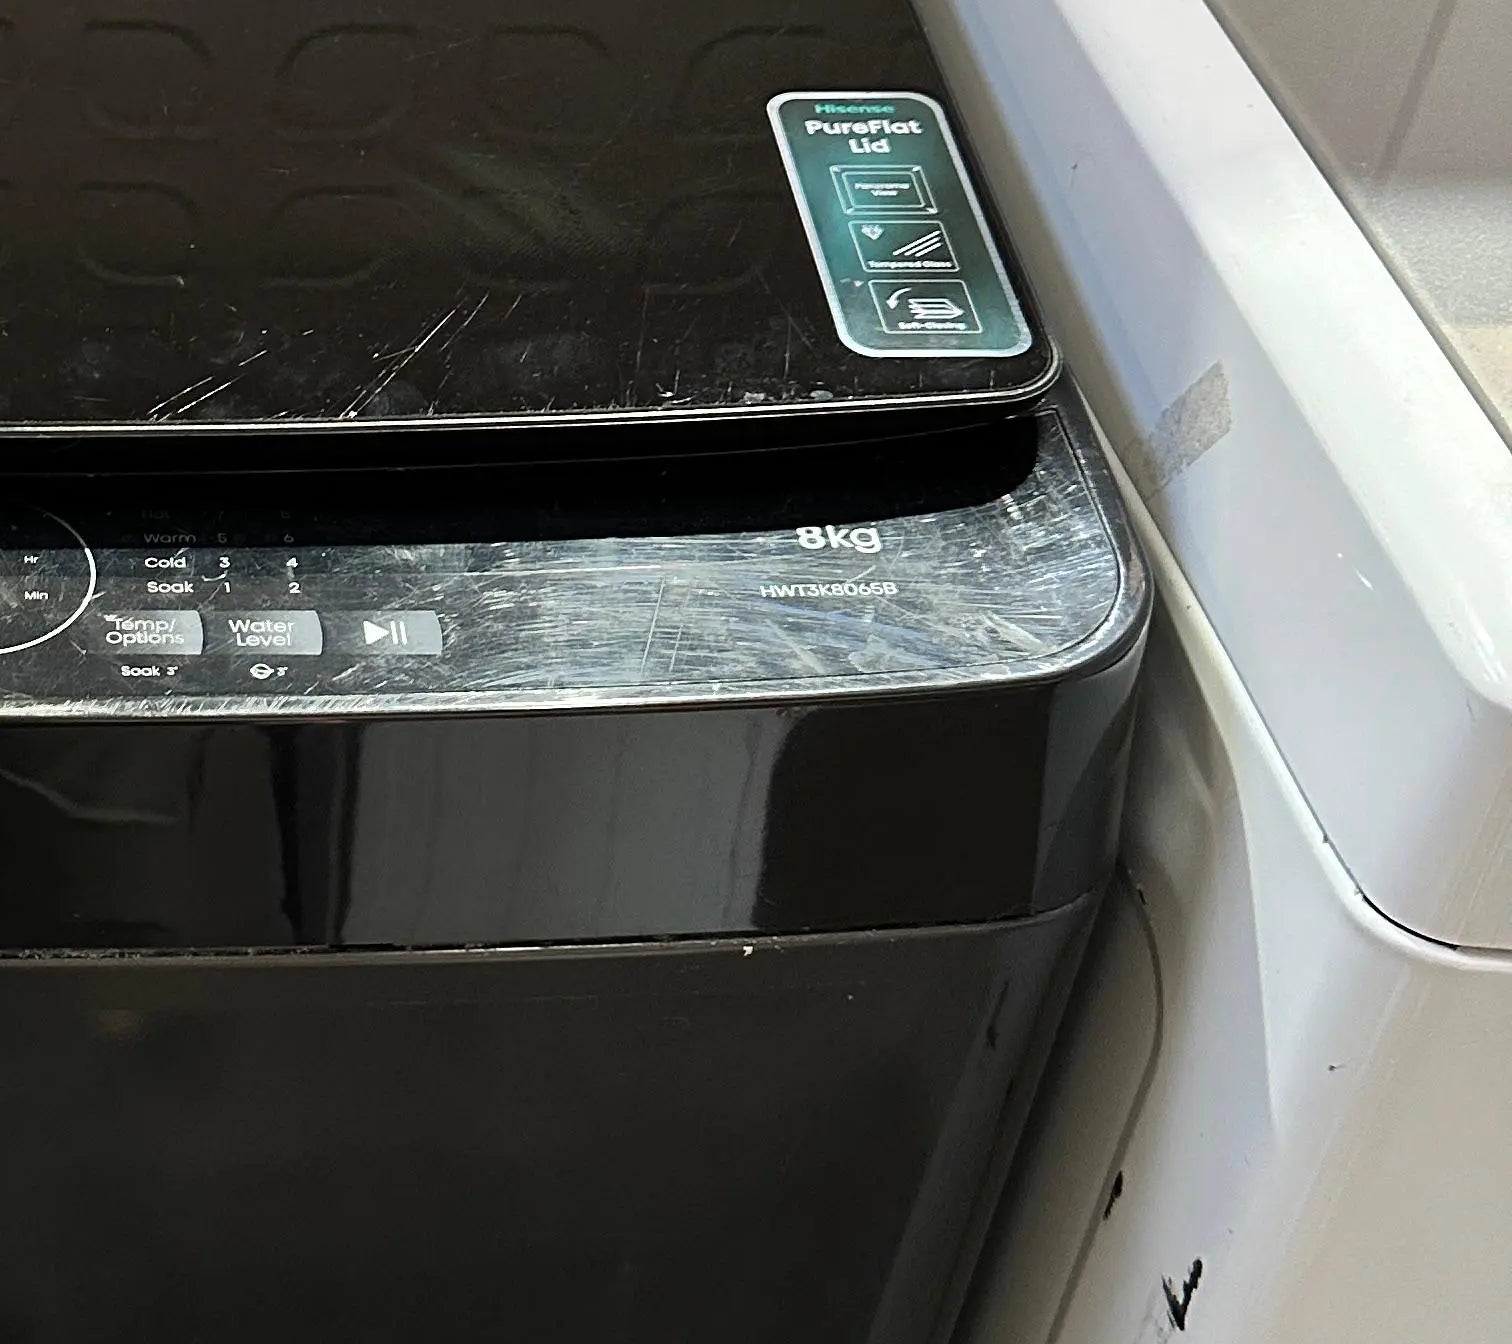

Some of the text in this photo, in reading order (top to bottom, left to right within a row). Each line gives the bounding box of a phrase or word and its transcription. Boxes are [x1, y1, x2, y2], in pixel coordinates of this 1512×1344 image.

[814, 103, 895, 115] Hisense
[804, 118, 924, 136] PureFlat
[847, 137, 892, 155] Lid
[143, 532, 197, 544] Warm
[283, 532, 294, 544] 6
[795, 524, 883, 554] 8kg
[23, 555, 40, 564] Hr
[144, 556, 187, 569] Cold
[219, 556, 231, 569] 3
[285, 556, 299, 569] 4
[146, 580, 195, 594] Soak
[223, 581, 232, 594] 1
[288, 581, 302, 594] 2
[24, 590, 49, 601] Min
[228, 619, 296, 634] Water
[105, 630, 185, 648] Options
[236, 632, 292, 647] Level
[120, 665, 161, 677] Soak
